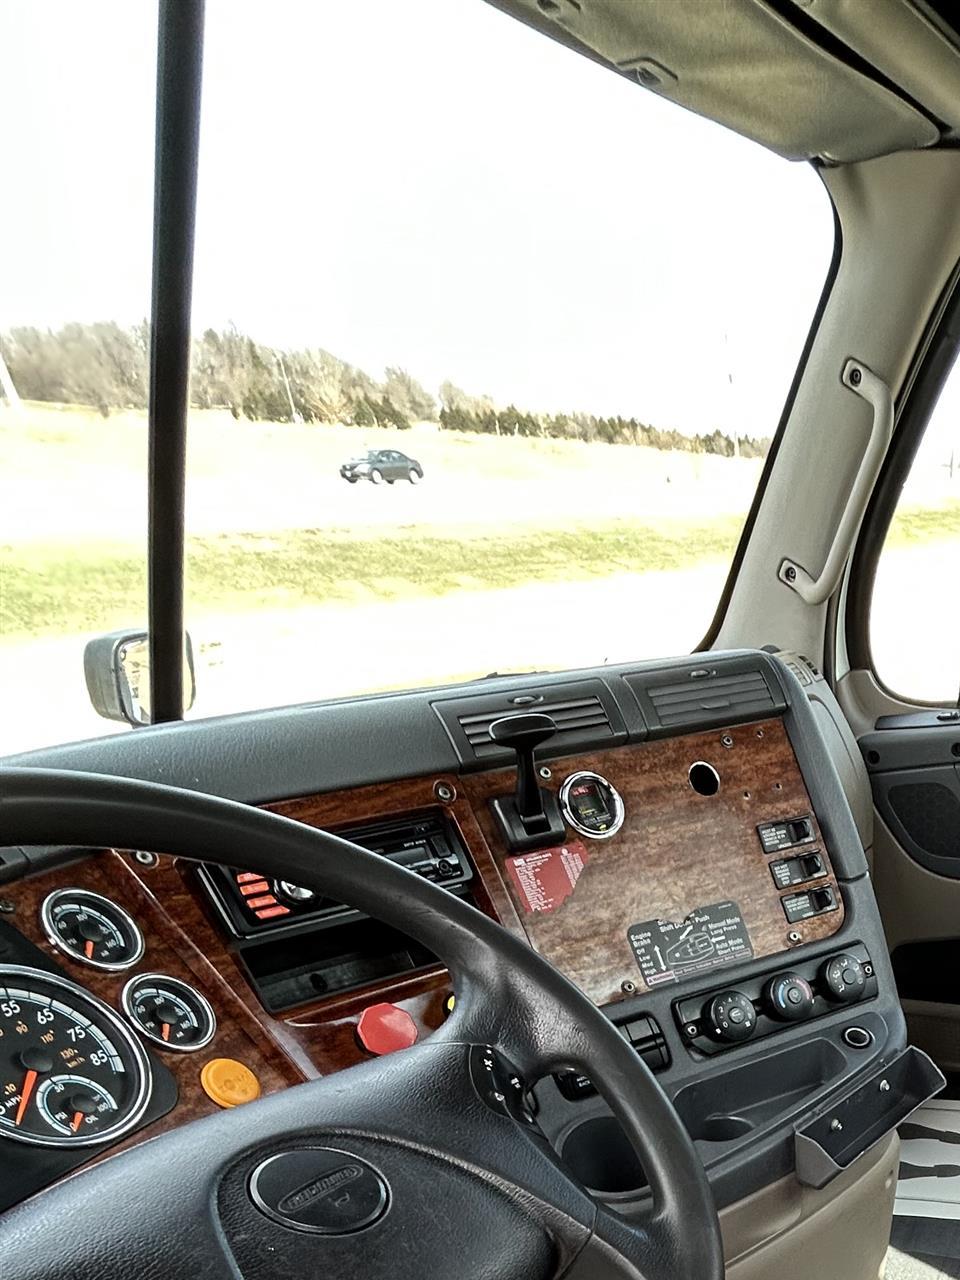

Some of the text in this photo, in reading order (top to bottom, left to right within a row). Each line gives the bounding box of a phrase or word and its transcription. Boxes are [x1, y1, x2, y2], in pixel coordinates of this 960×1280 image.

[630, 931, 652, 941] Engine
[1, 1000, 21, 1018] 55
[37, 1008, 55, 1025] 65
[40, 1033, 55, 1044] 110
[67, 1025, 86, 1042] 75
[90, 1049, 108, 1067] 85
[5, 1094, 22, 1109] MPH
